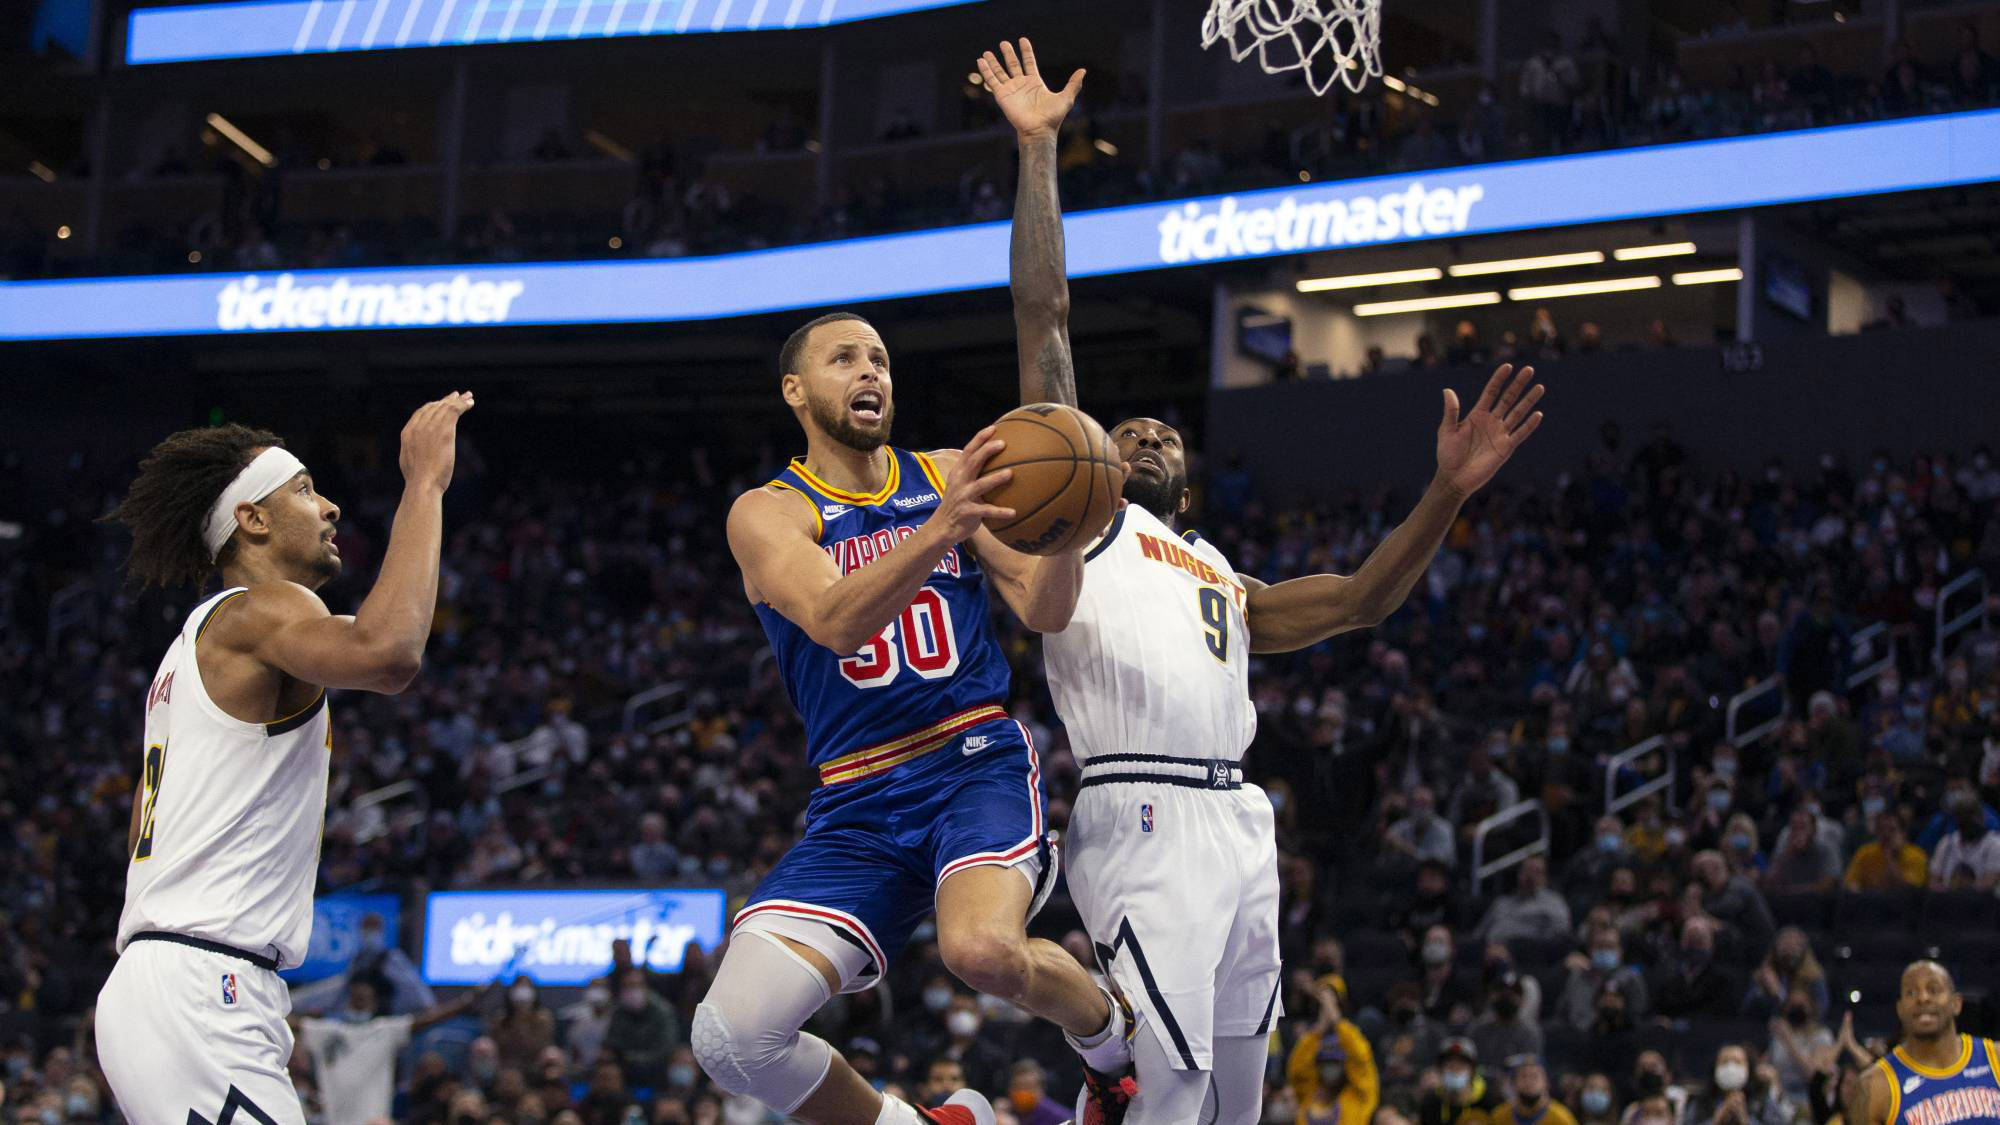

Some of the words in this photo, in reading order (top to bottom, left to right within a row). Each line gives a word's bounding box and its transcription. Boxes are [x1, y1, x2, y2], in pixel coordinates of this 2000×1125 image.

[1157, 181, 1484, 264] ticketmaster
[216, 273, 525, 331] ticketmaster
[824, 504, 845, 515] NIKE
[893, 493, 938, 508] Rakuten
[839, 586, 960, 690] 30
[1198, 586, 1228, 664] 9
[965, 735, 988, 748] NIKE
